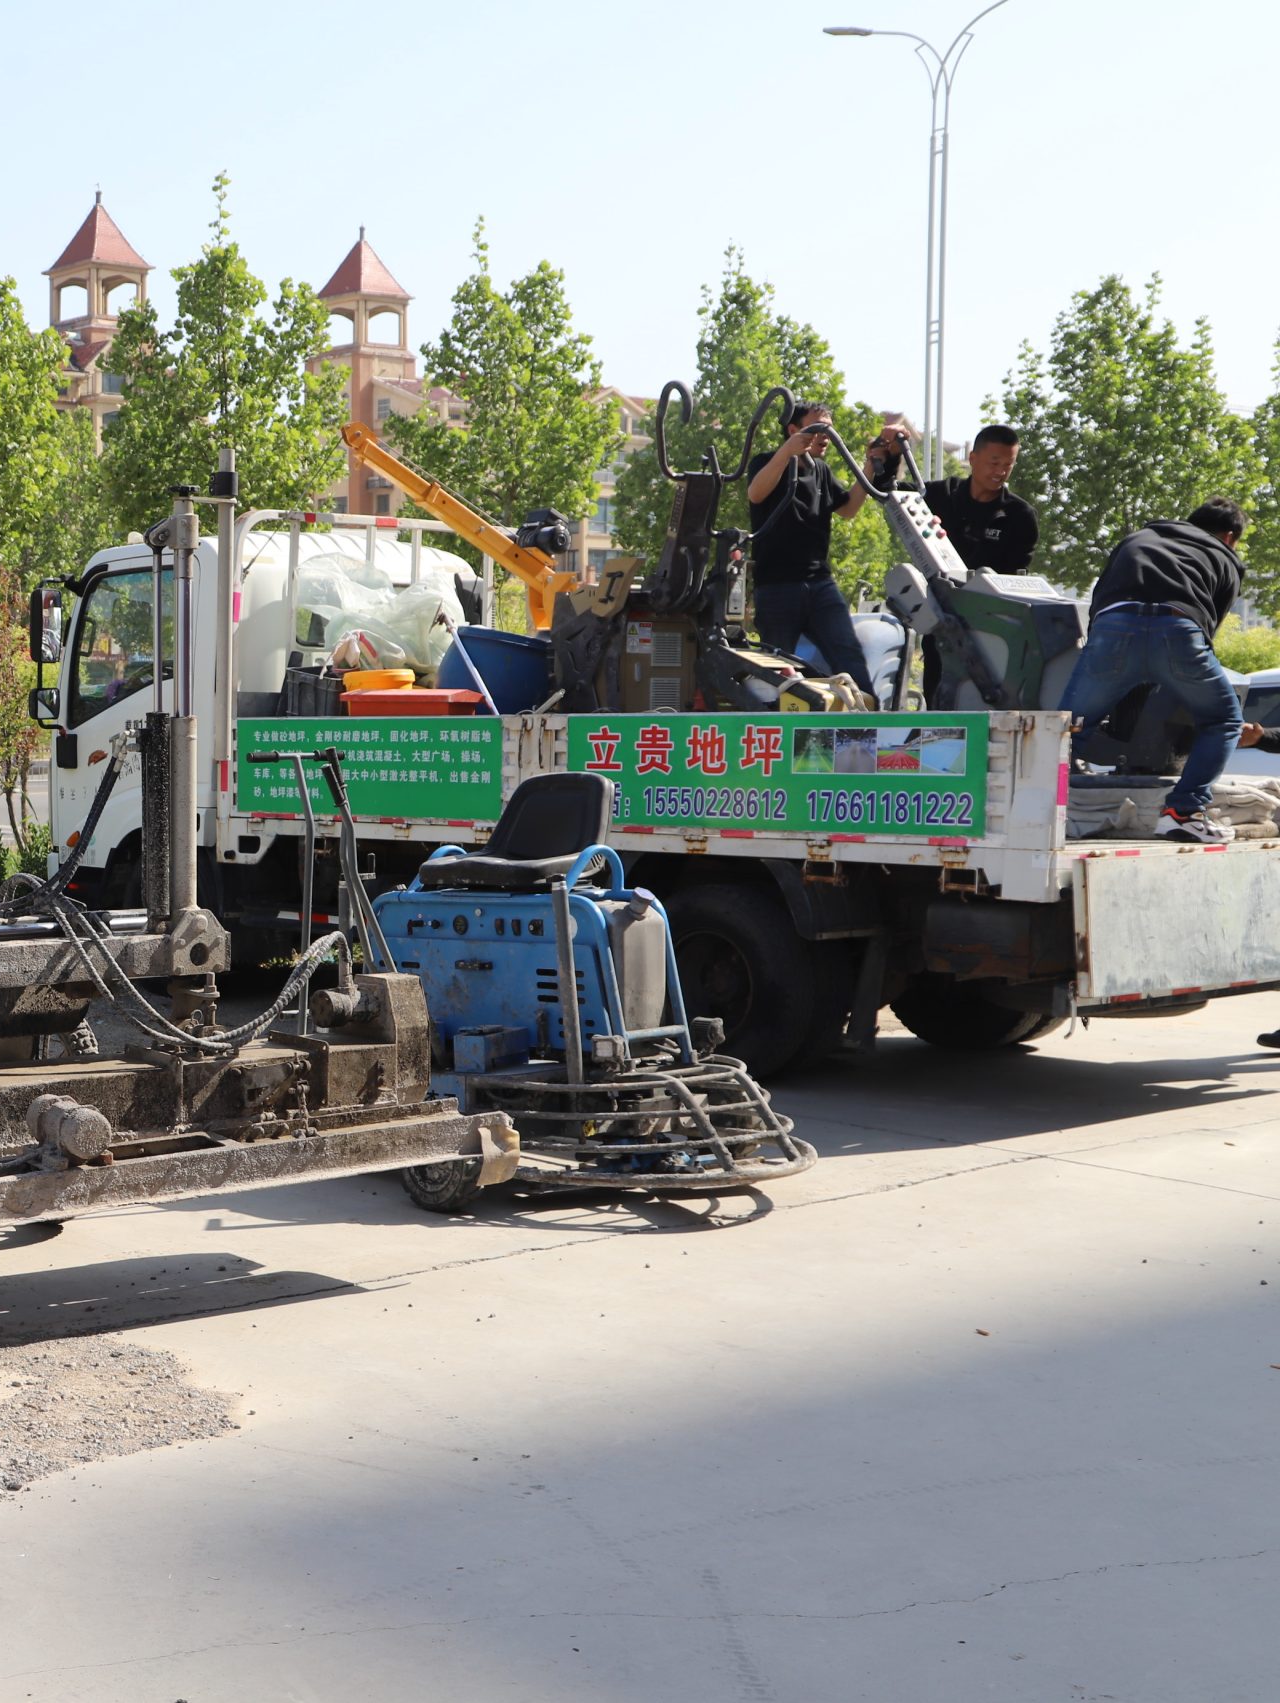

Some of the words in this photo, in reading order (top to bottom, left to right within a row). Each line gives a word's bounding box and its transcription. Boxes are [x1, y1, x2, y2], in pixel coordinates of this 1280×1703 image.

[584, 724, 785, 777] 立贵地坪
[642, 786, 788, 821] 15550228612
[806, 789, 974, 826] 17661181222
